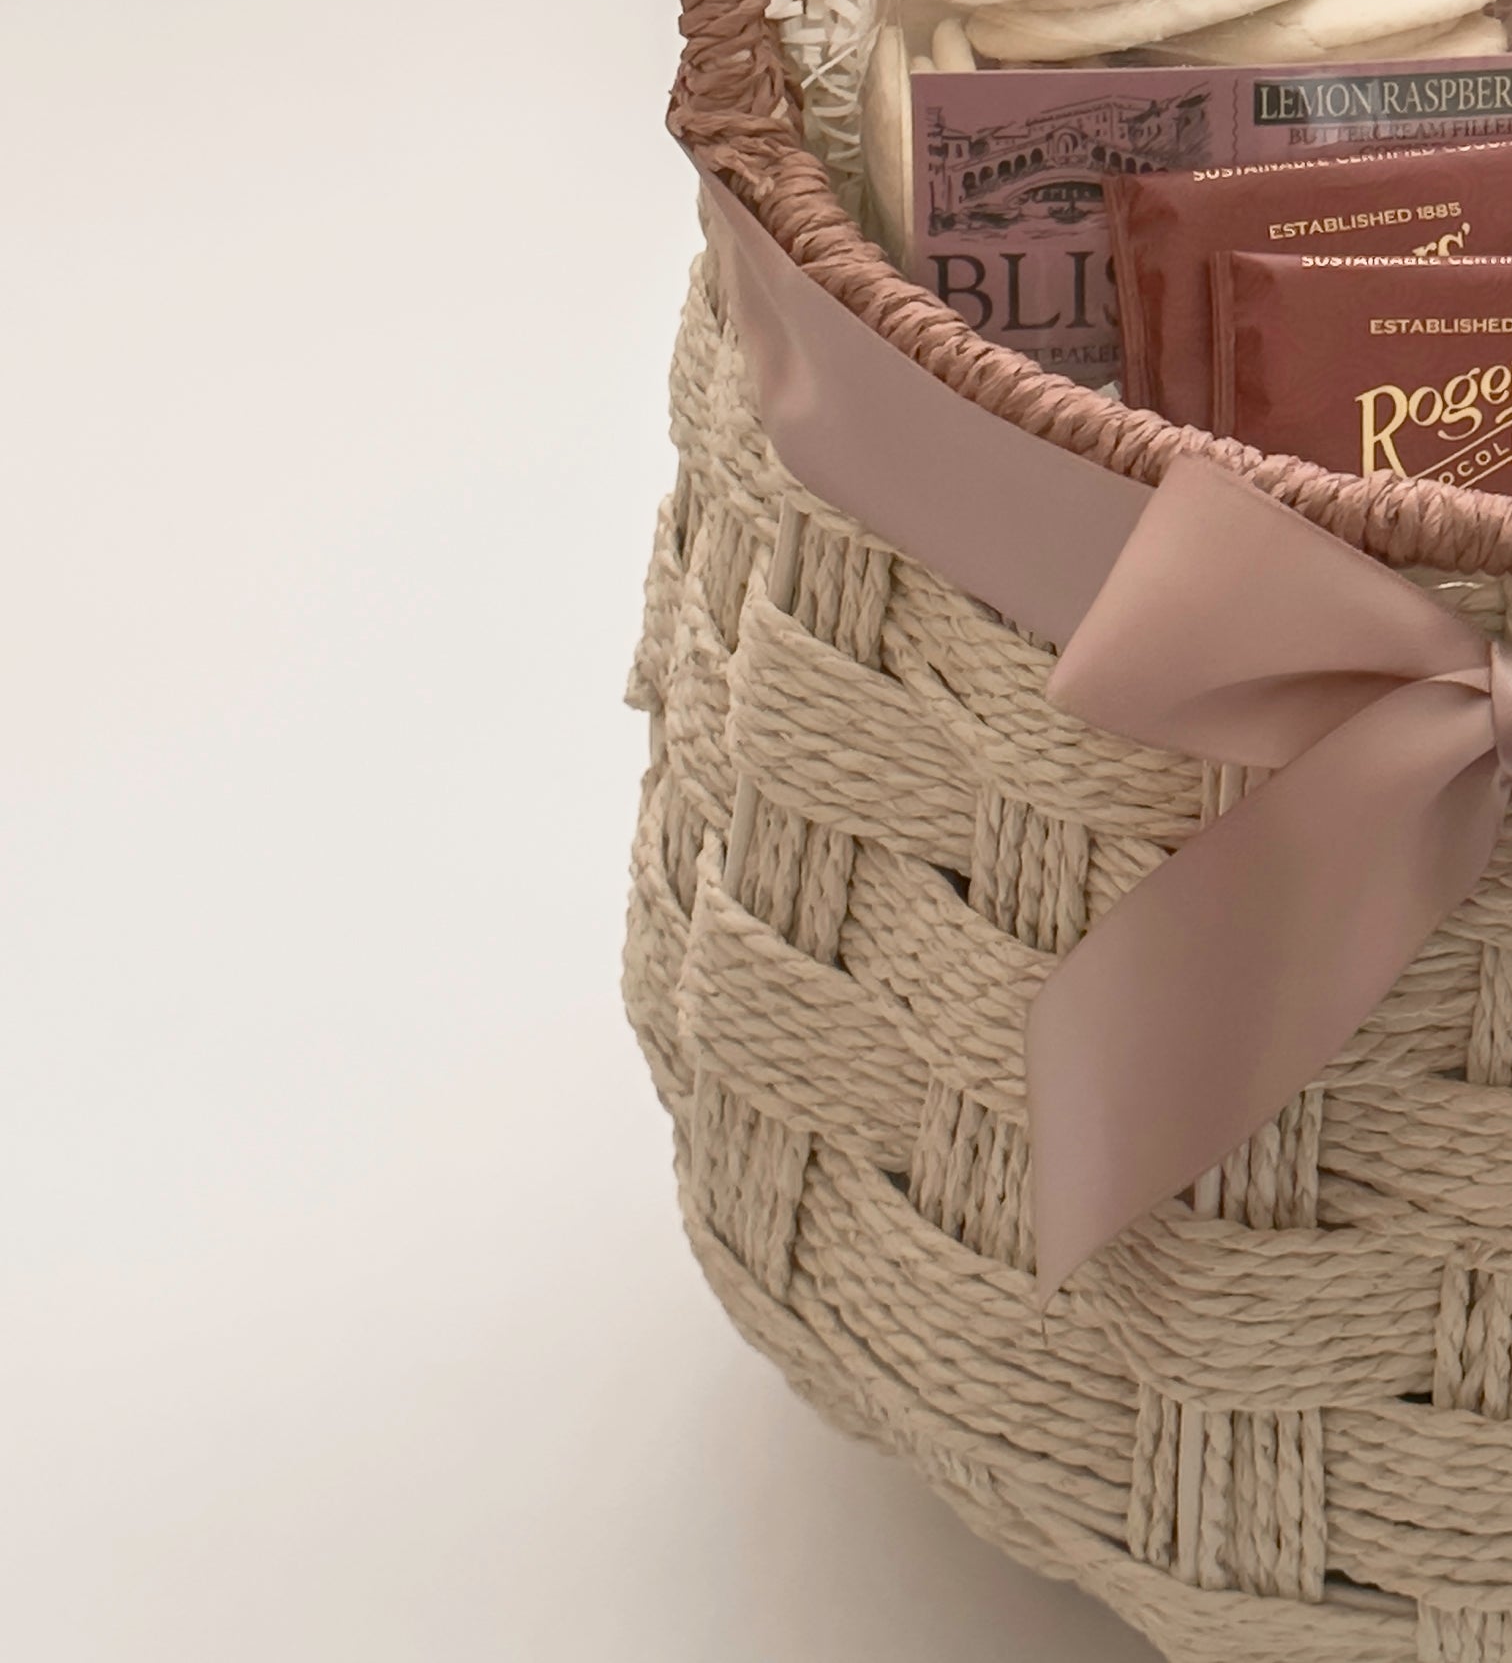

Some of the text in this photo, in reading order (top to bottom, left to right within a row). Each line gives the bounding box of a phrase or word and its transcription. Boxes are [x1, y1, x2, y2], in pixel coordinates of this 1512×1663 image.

[1260, 82, 1374, 121] LEMON
[1269, 209, 1412, 240] ESTABLISHED
[1416, 201, 1462, 220] 1885
